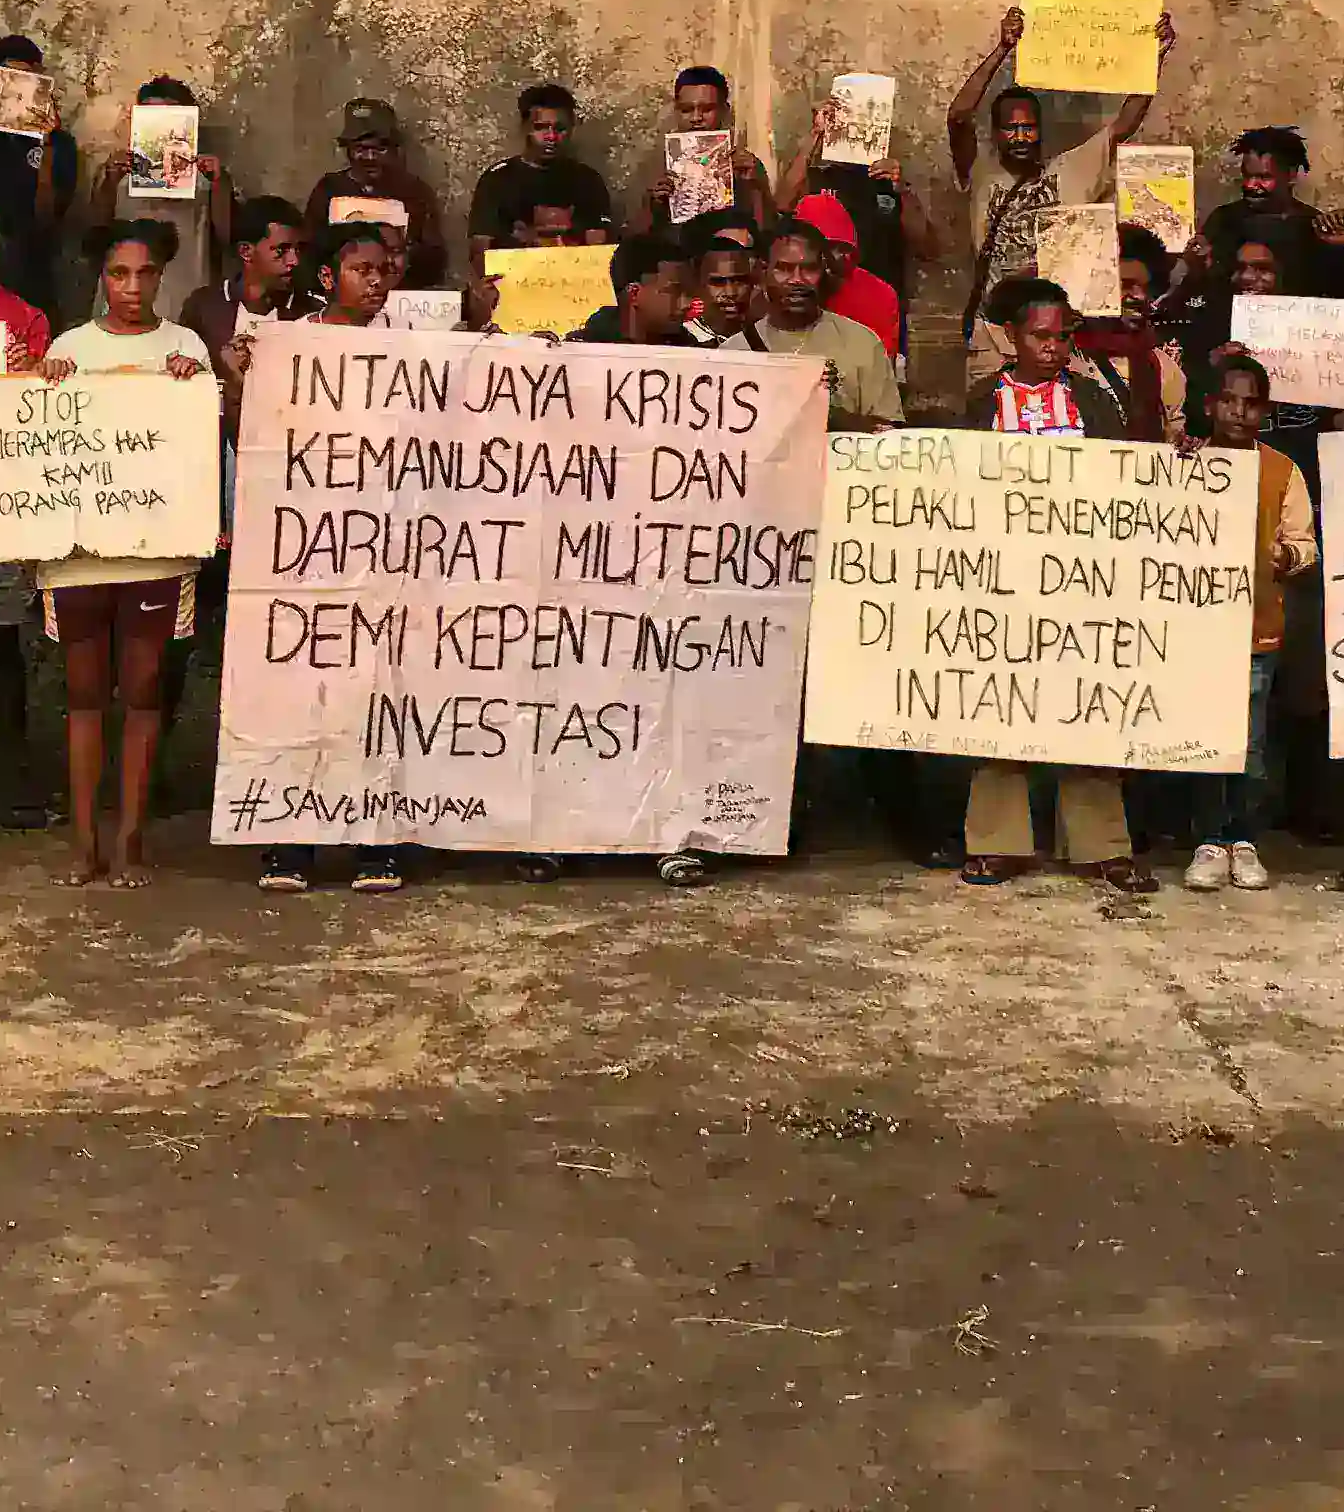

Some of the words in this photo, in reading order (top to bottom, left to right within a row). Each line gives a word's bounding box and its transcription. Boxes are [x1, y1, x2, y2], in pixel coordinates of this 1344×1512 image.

[16, 387, 93, 426] STOP
[289, 352, 452, 413] INTAN
[462, 360, 576, 422] JAYA
[604, 367, 762, 435] KRISIS
[114, 428, 169, 455] HAK
[284, 427, 619, 502] KEMANUSIAAN
[650, 444, 749, 503] DAN
[830, 435, 957, 475] SEGERA
[977, 440, 1086, 486] USUT
[1109, 447, 1234, 496] TUNTAS
[94, 488, 168, 515] PAPUA
[845, 484, 977, 532] PELAKU
[1003, 488, 1220, 547] PENEMBAKAN
[272, 504, 527, 582] DARURAT
[554, 511, 820, 591] MILITERISME
[829, 538, 899, 585] IBU
[913, 546, 1016, 596] HAMIL
[1039, 553, 1118, 599] DAN
[1138, 556, 1254, 607] PENDETA
[265, 596, 409, 670] DEMI
[434, 602, 771, 674] KEPENTINGAN
[858, 600, 896, 653] DI
[924, 605, 1169, 670] KABUPATEN
[362, 691, 643, 761] INVESTASI
[895, 668, 1040, 727] INTAN
[1057, 677, 1164, 734] JAYA
